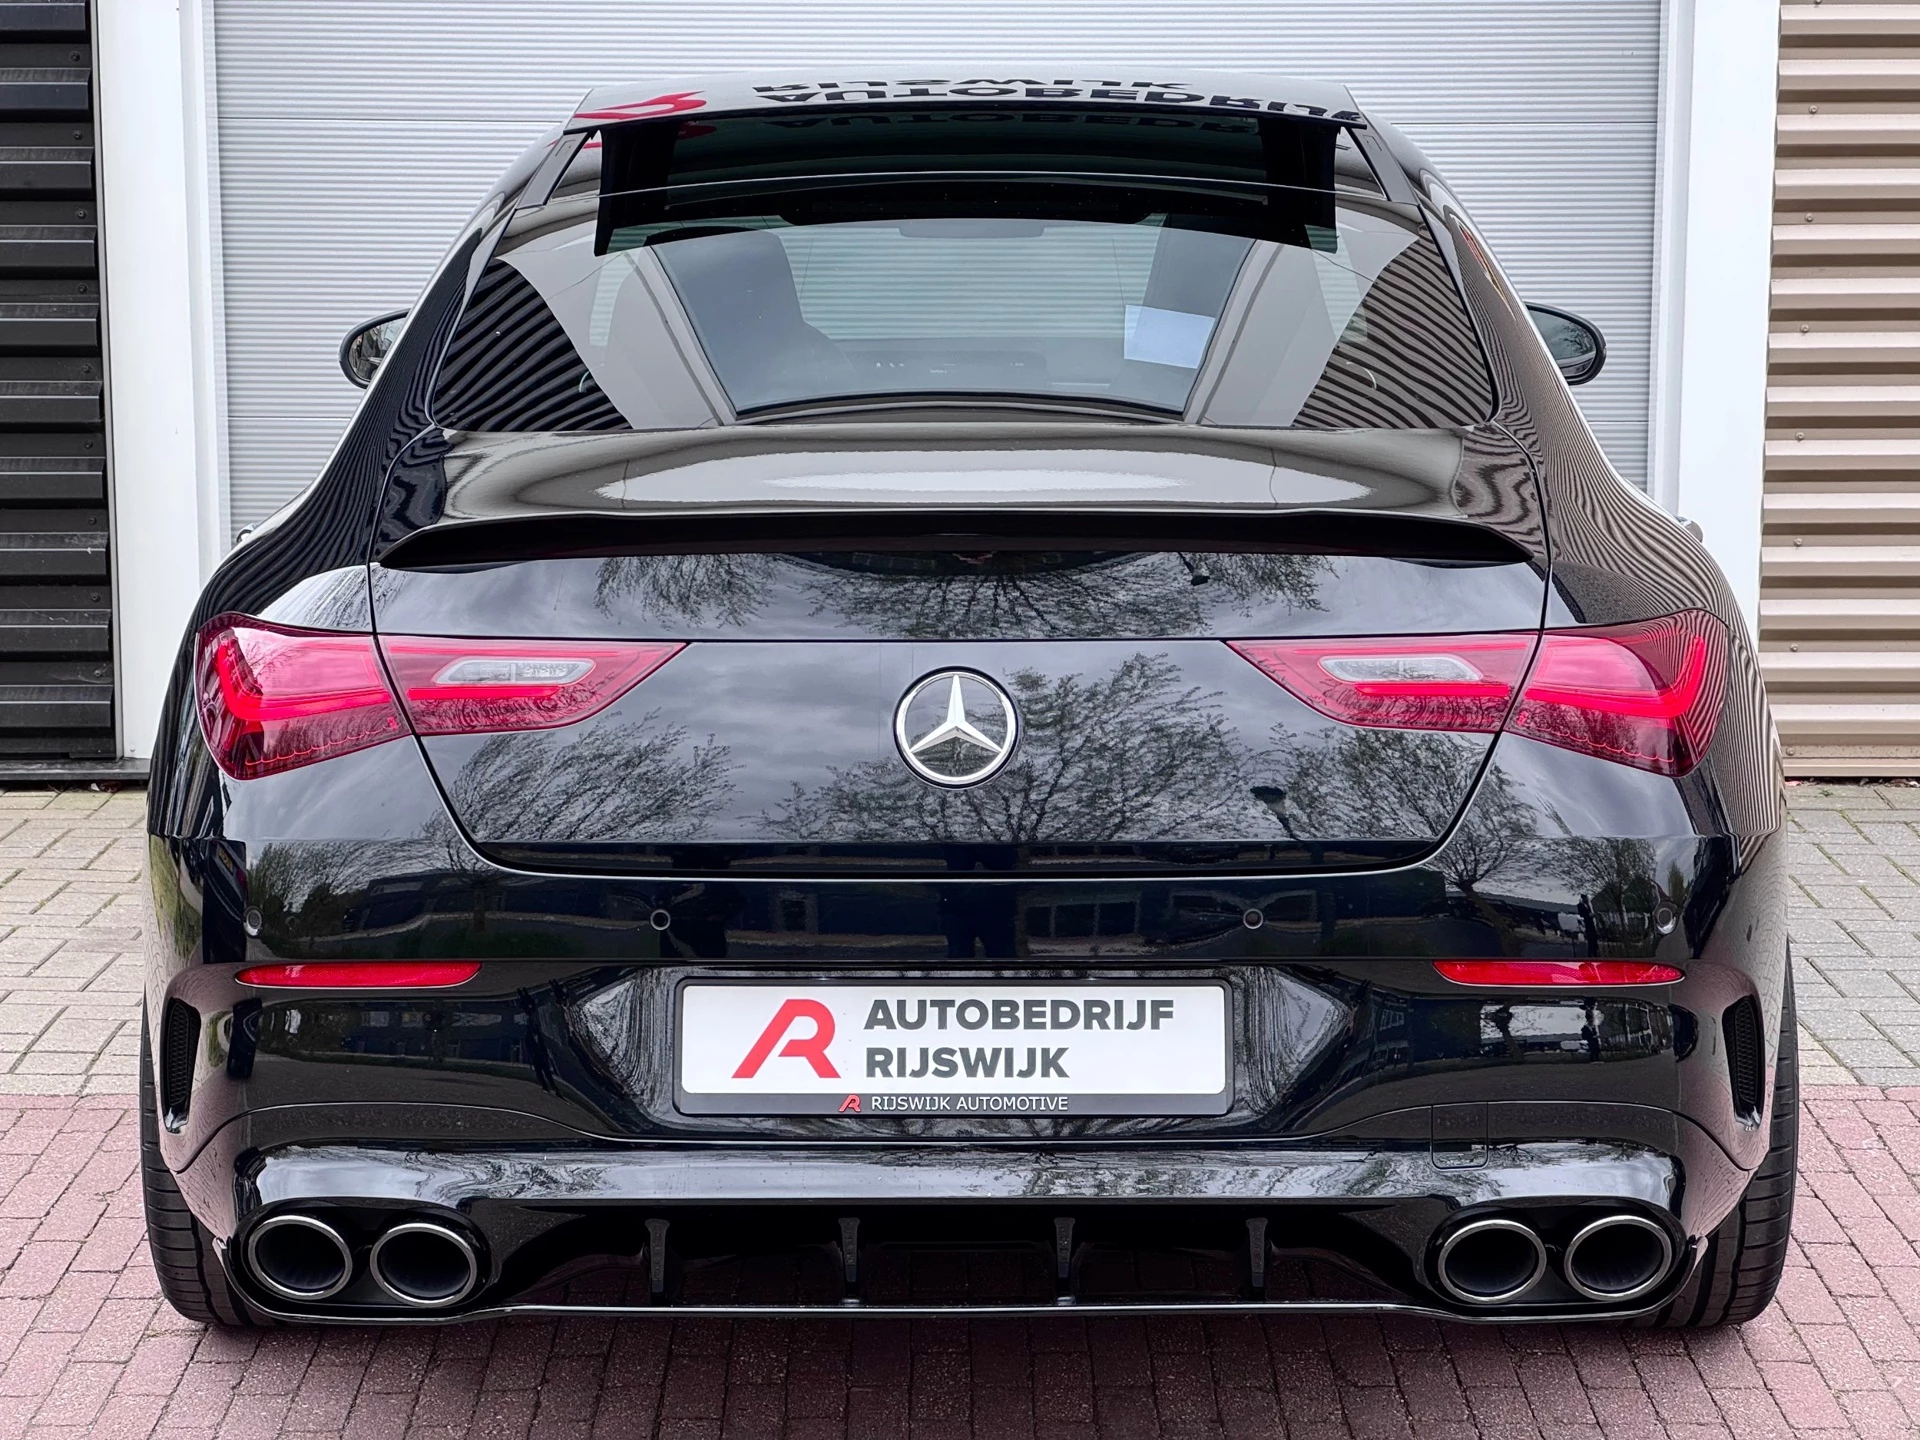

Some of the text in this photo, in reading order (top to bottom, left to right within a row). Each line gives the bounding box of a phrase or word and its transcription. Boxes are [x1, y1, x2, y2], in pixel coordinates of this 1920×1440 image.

[864, 999, 1174, 1030] AUTOBEDRIJF
[866, 1047, 1070, 1078] RIJSWIJK
[871, 1096, 1068, 1111] RIJSWIJK AUTOMOTIVE
